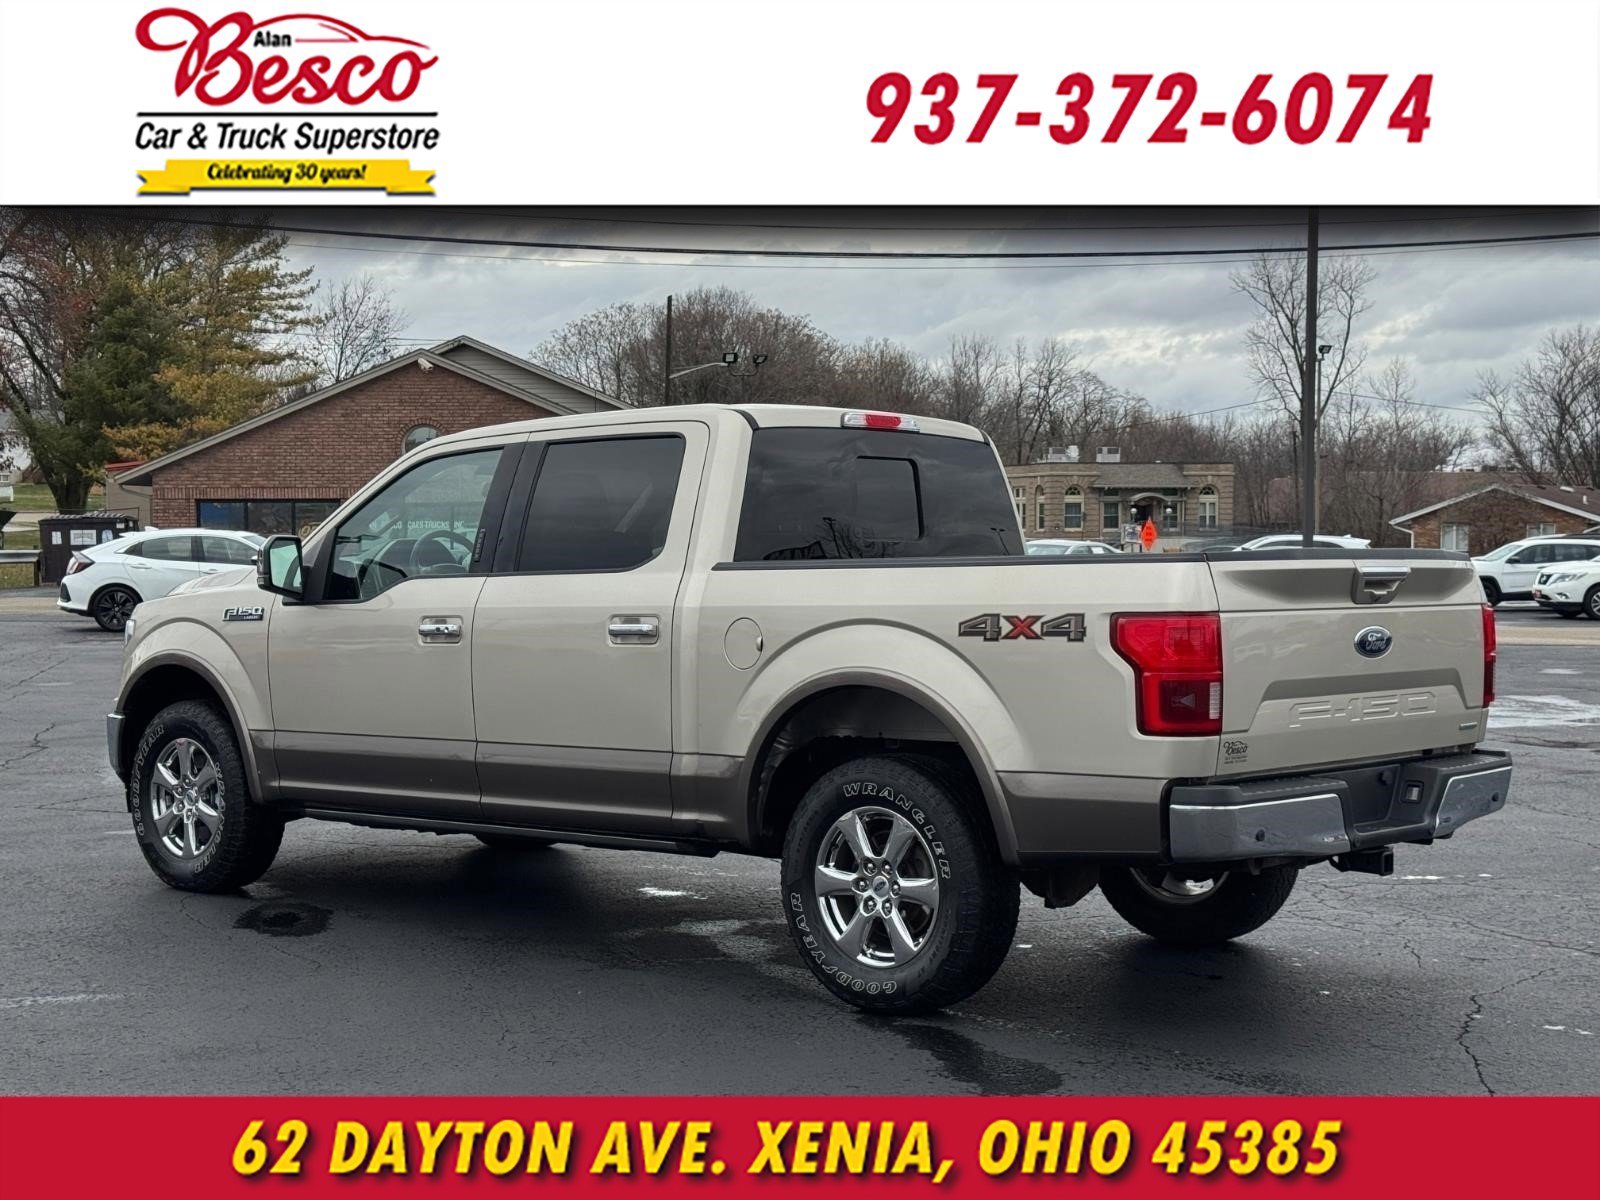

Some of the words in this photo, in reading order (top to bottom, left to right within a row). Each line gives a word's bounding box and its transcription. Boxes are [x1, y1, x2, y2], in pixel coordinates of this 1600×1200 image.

[1365, 632, 1388, 650] Ford
[843, 782, 951, 880] WRANGLER
[790, 892, 898, 995] GOODYEAR
